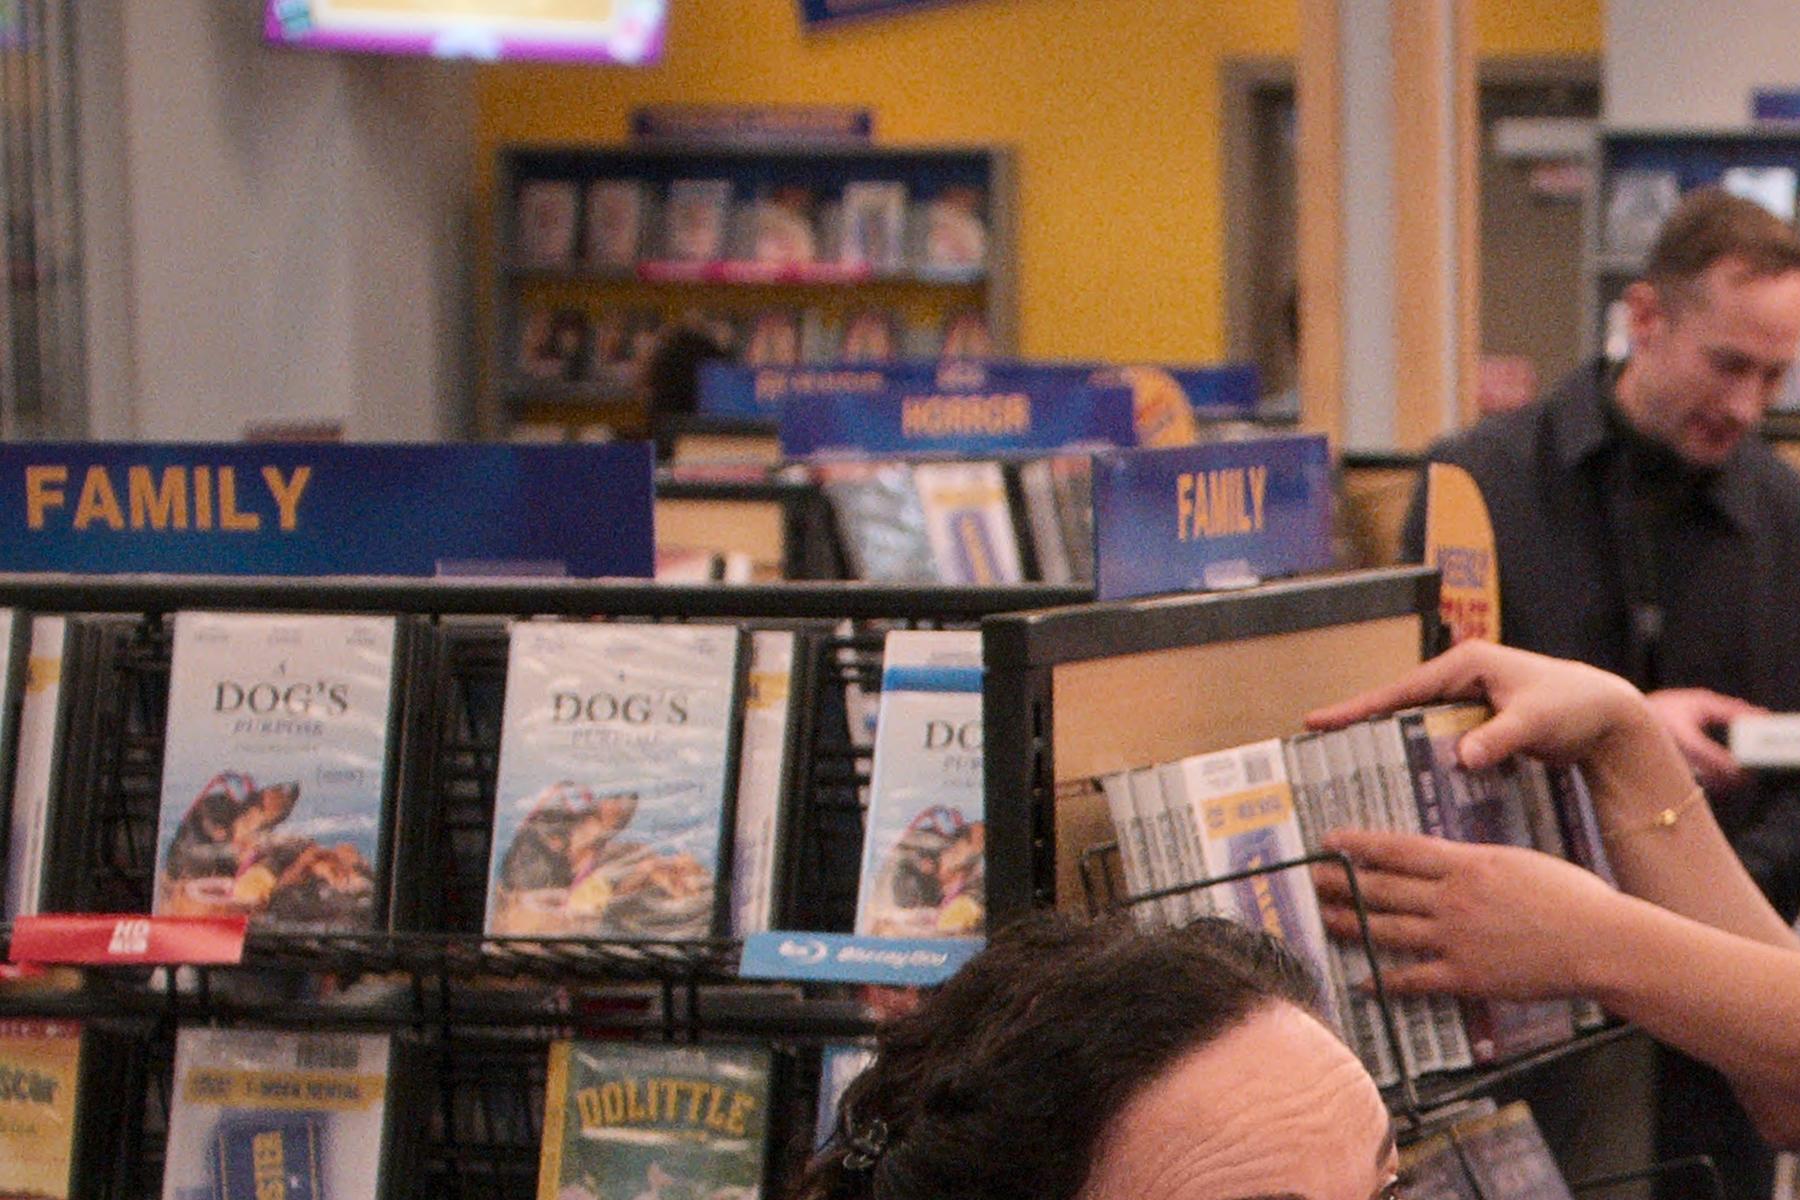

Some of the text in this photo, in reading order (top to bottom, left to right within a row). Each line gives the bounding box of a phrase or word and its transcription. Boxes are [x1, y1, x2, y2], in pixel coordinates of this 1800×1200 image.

[25, 465, 312, 532] FAMILY
[1176, 464, 1268, 543] FAMILY
[214, 681, 348, 715] DOG'S
[577, 1078, 756, 1136] DOLITTLE
